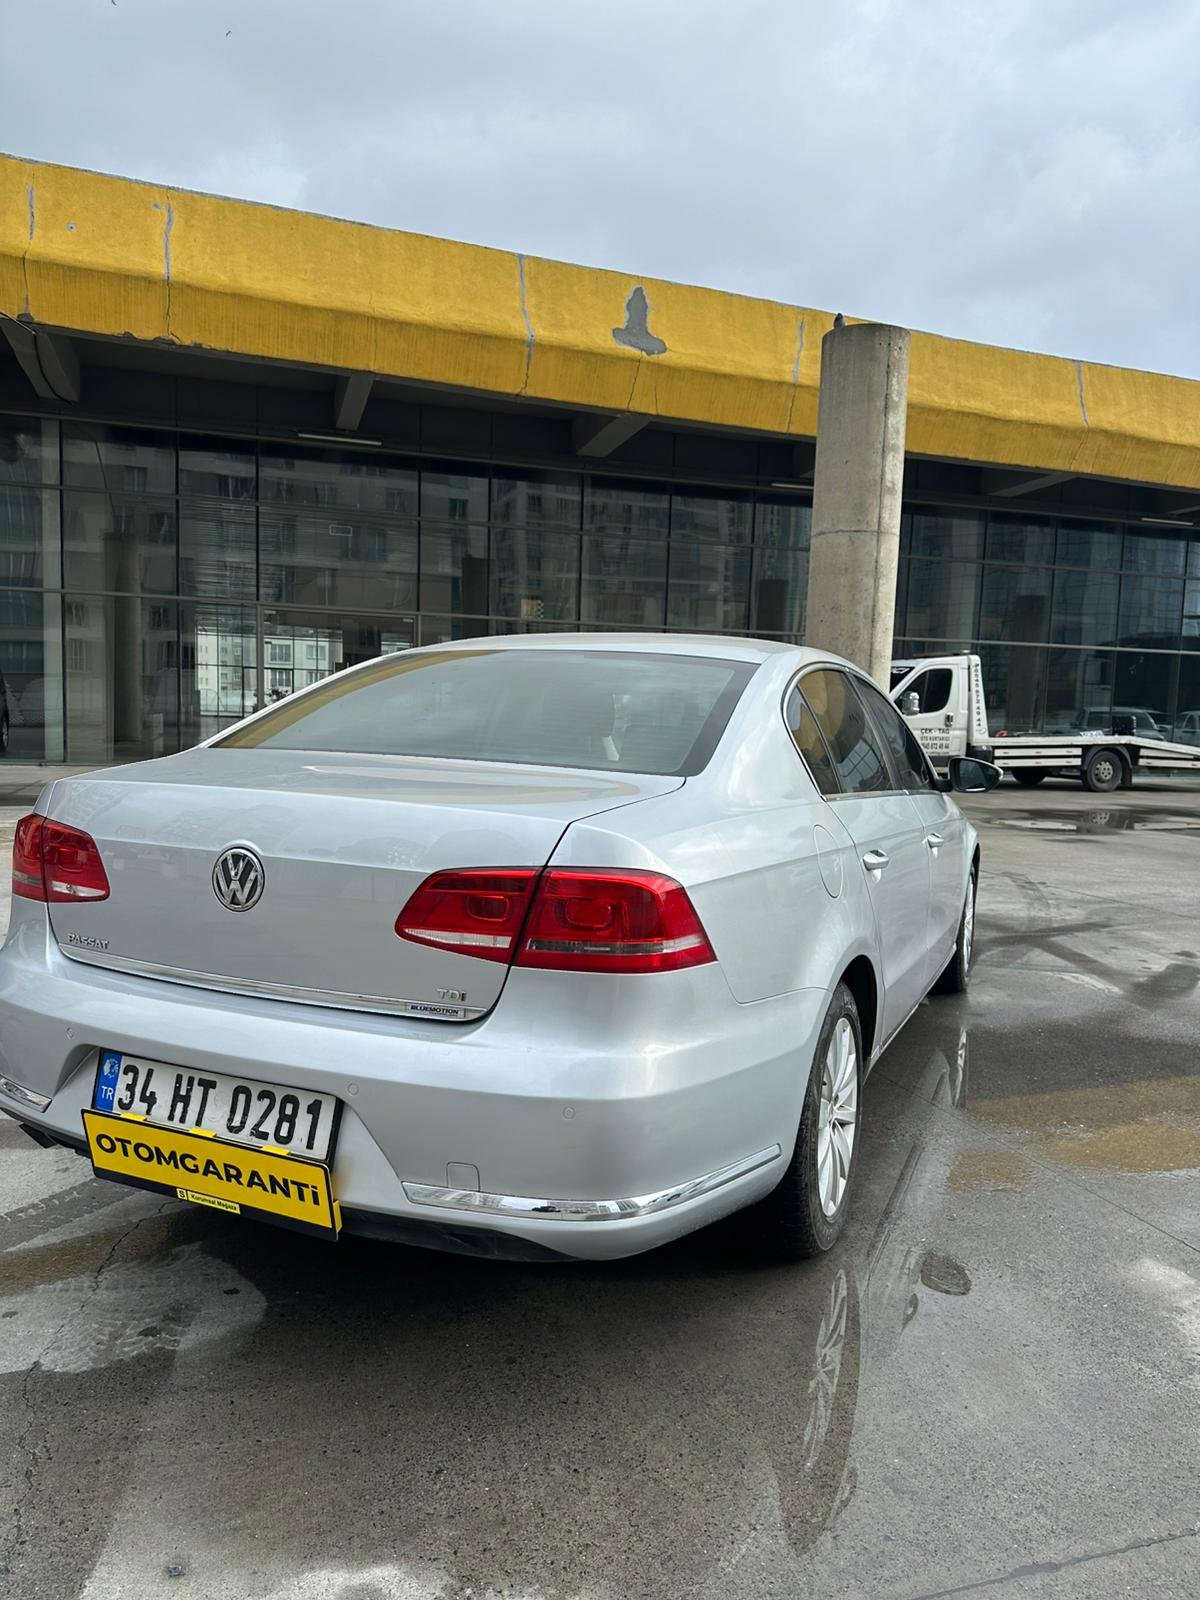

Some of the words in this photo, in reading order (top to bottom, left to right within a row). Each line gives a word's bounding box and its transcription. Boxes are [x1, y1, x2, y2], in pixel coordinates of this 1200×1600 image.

[214, 849, 262, 910] VW
[67, 933, 109, 950] PASSAT
[436, 988, 467, 1001] TDI
[410, 1004, 460, 1015] BLUEMOTION
[101, 1086, 114, 1101] TR
[117, 1064, 157, 1116] 34
[167, 1073, 217, 1127] HT
[226, 1084, 323, 1151] 0281
[179, 1190, 186, 1199] S
